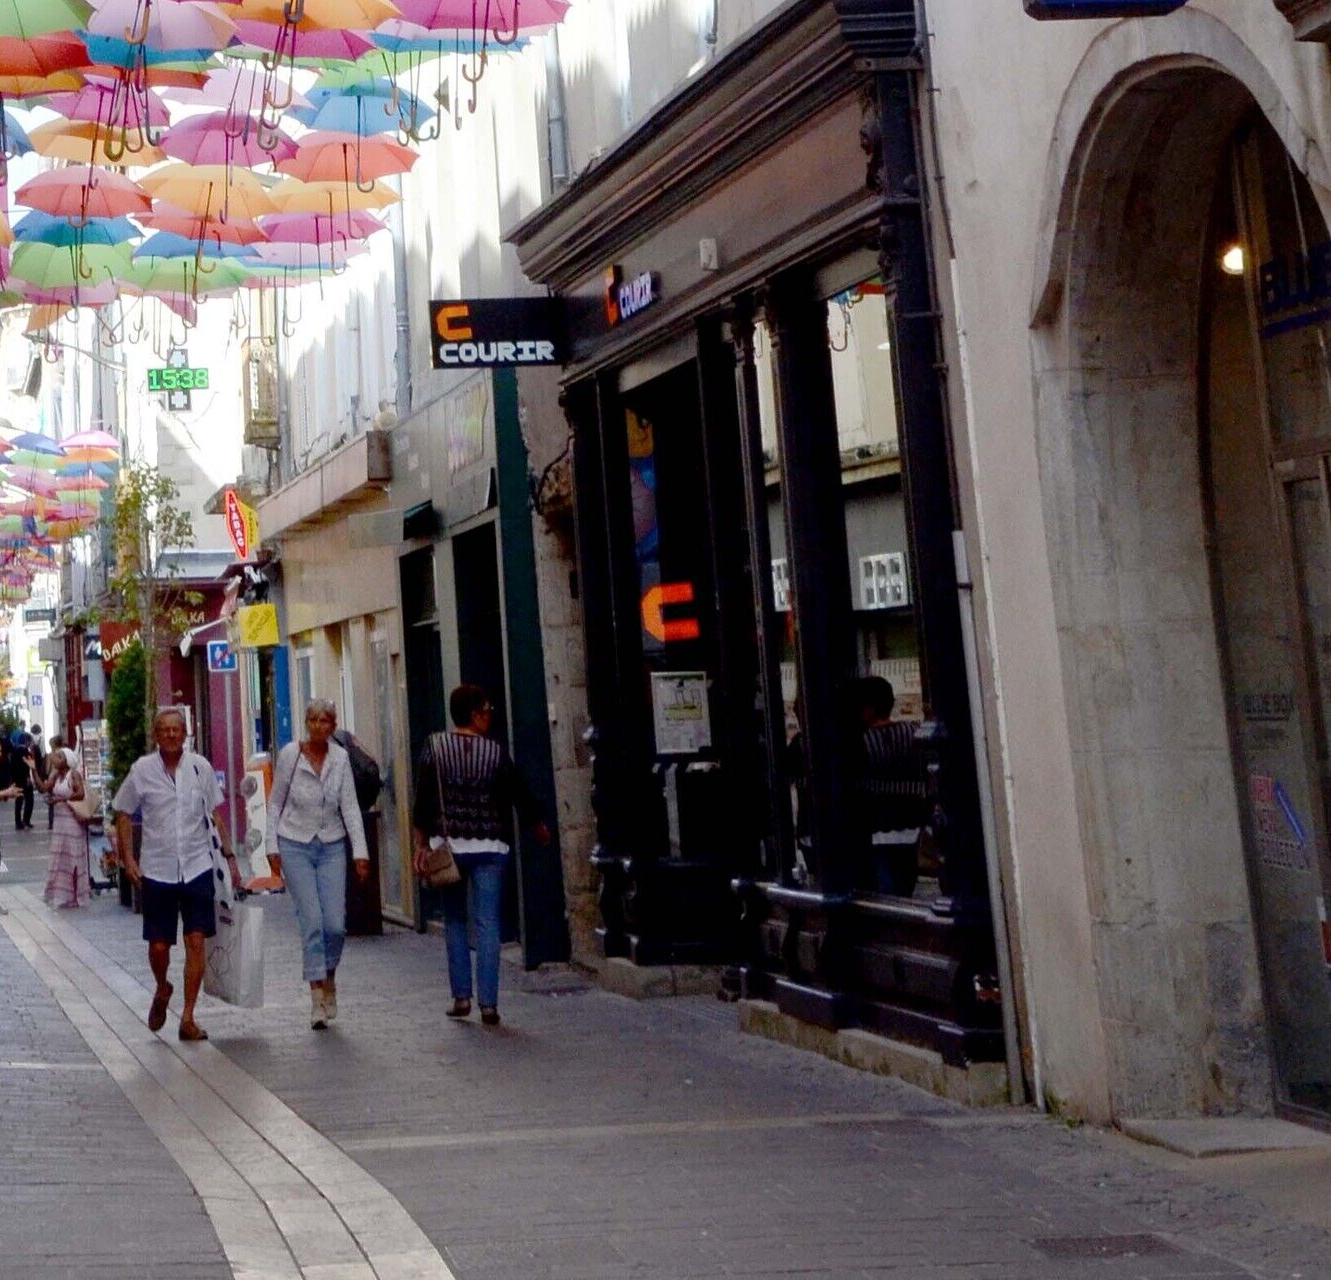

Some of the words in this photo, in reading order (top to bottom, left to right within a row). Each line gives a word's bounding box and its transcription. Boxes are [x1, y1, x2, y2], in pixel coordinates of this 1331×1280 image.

[619, 270, 652, 319] COURIR
[439, 340, 555, 363] COURIR
[149, 368, 209, 390] 15:38
[229, 503, 244, 547] TABAC
